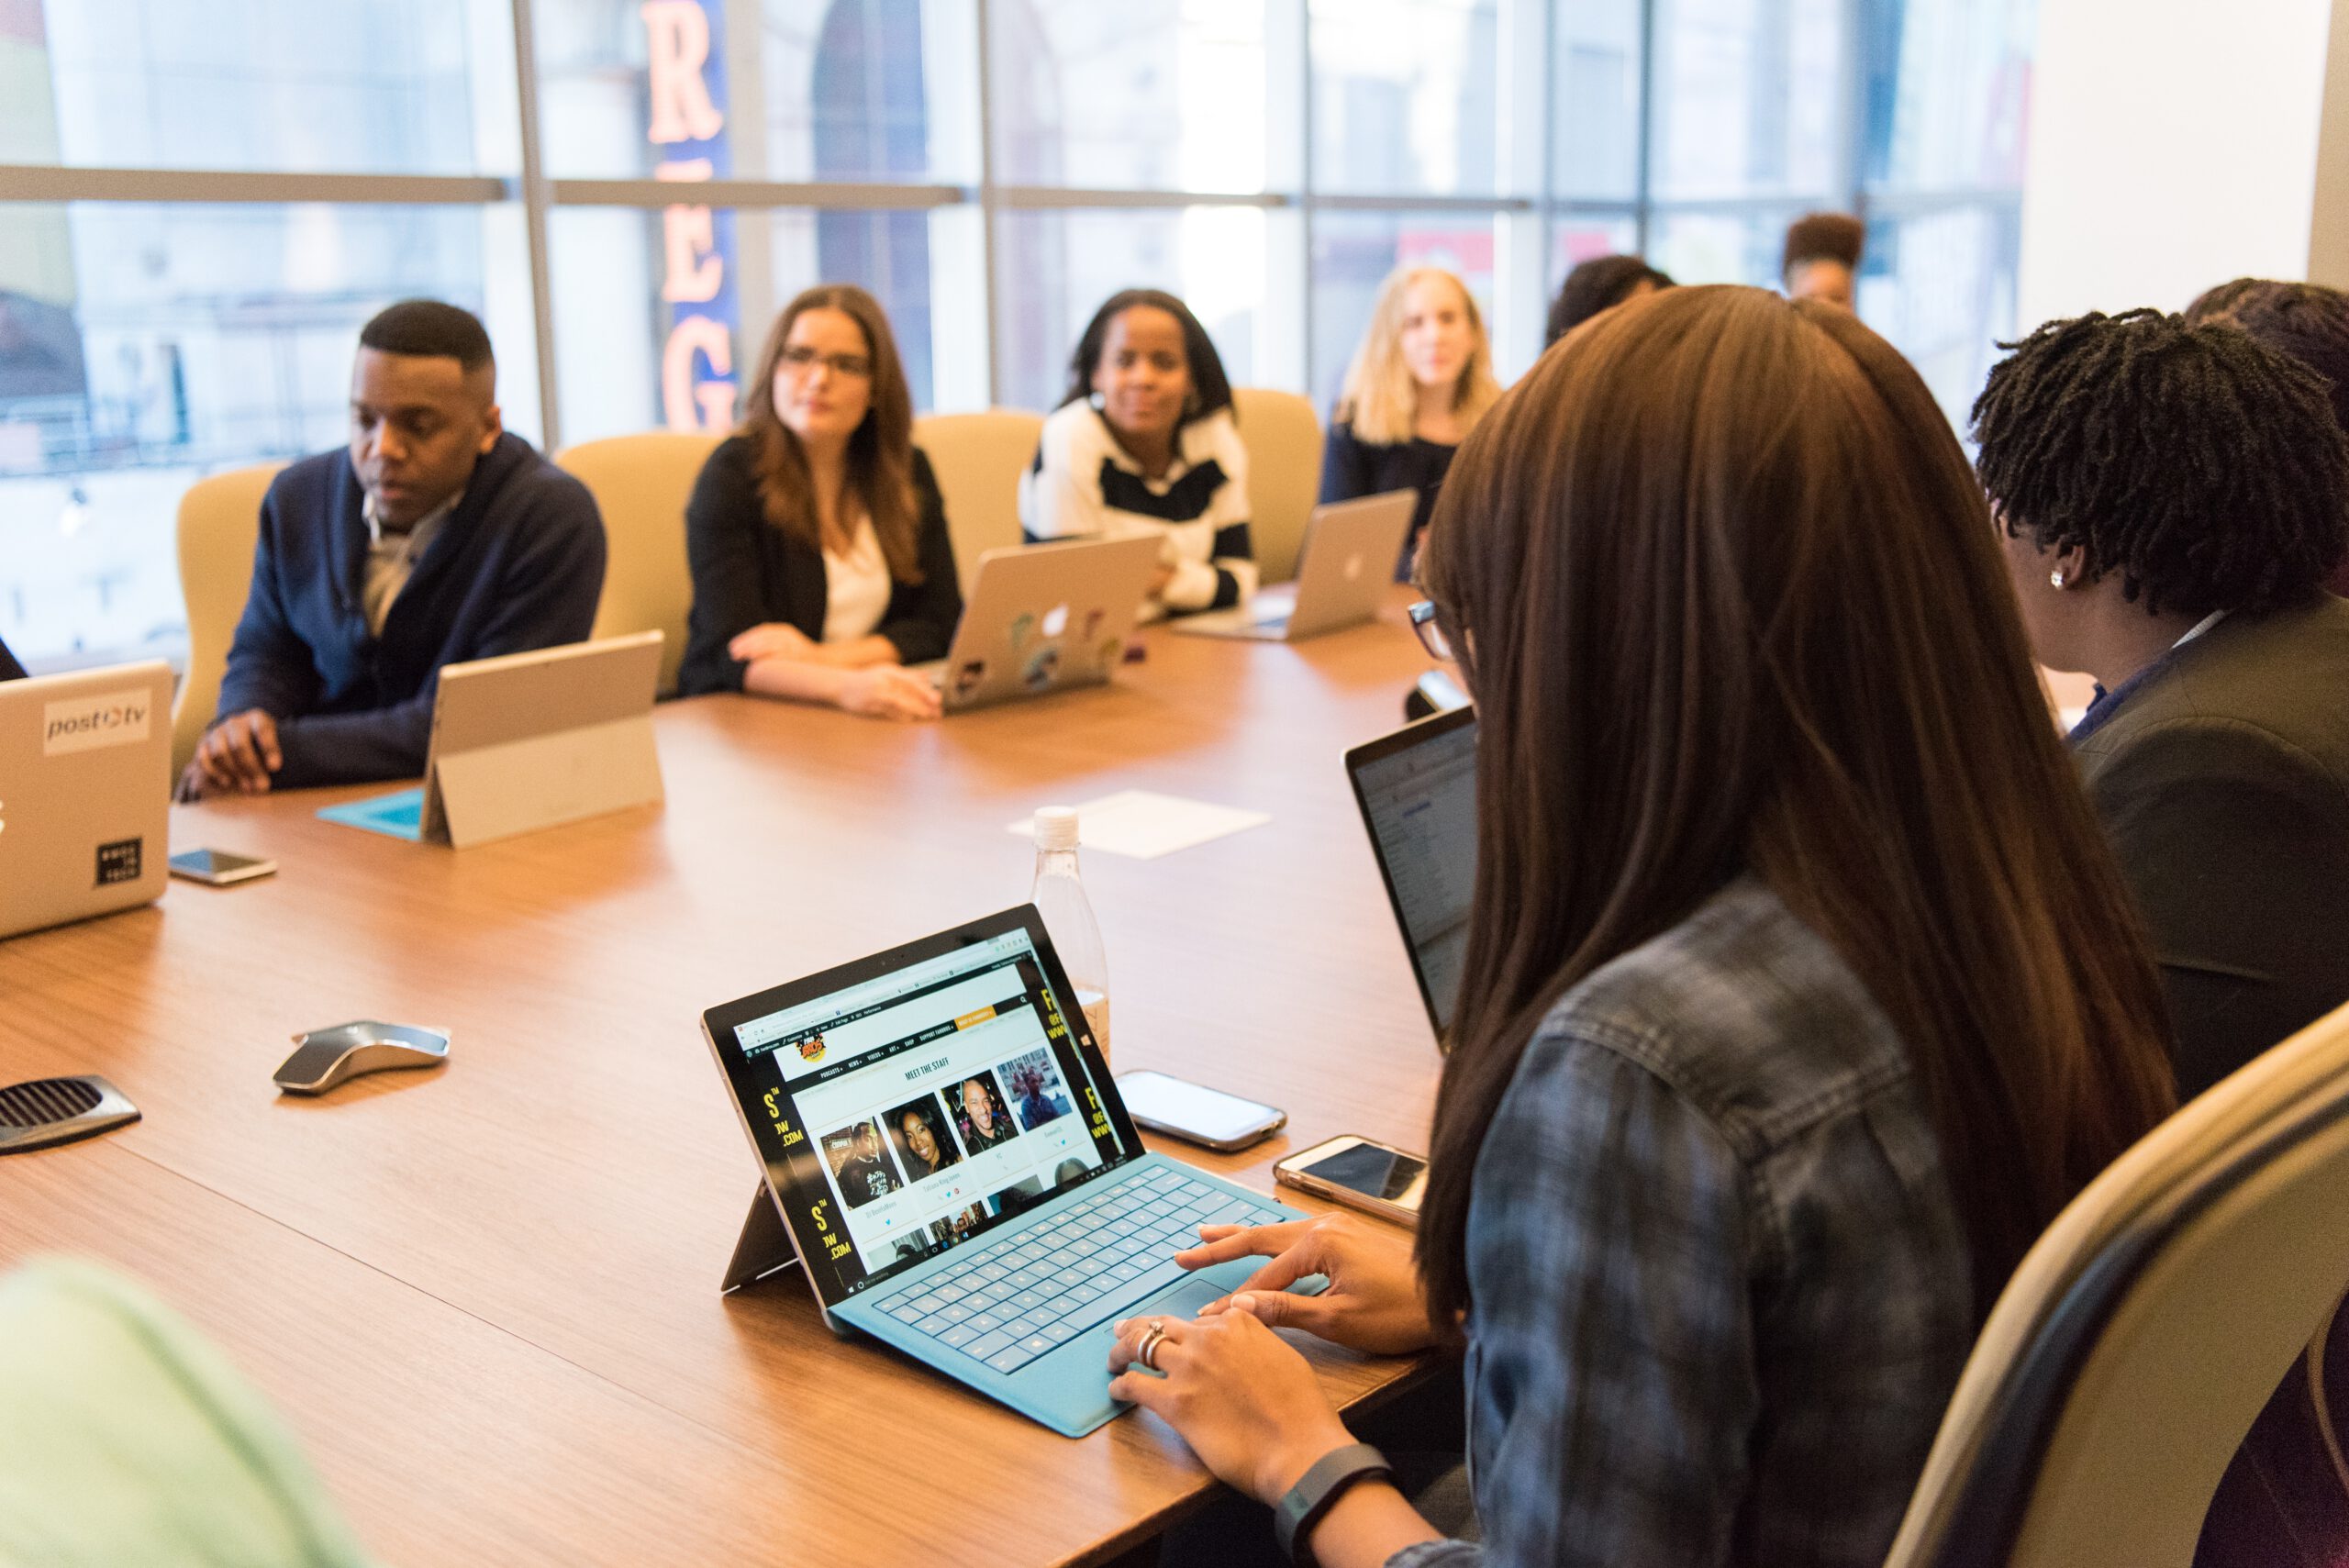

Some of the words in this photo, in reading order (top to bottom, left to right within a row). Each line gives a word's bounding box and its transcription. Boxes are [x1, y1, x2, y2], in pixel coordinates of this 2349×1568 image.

[919, 1031, 935, 1040] SUPPORT
[867, 1051, 880, 1060] VIDEOS
[820, 1067, 839, 1078] PODCASTS
[905, 1068, 920, 1080] MEET
[920, 1064, 931, 1074] THE
[932, 1057, 949, 1069] STAFF
